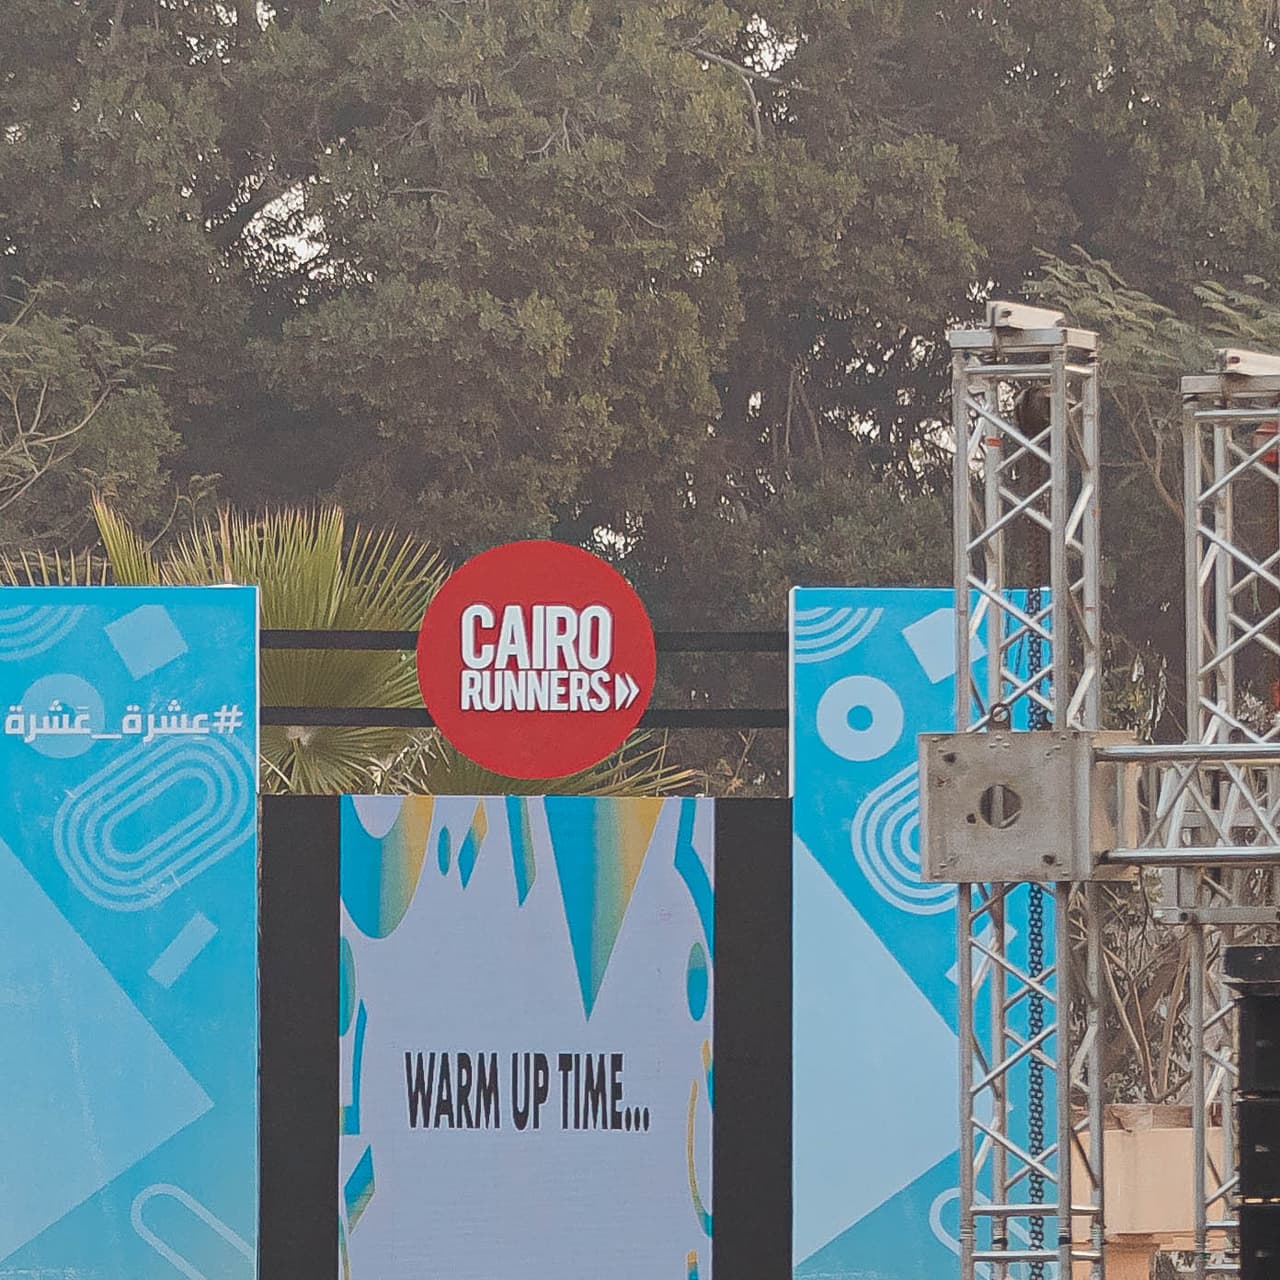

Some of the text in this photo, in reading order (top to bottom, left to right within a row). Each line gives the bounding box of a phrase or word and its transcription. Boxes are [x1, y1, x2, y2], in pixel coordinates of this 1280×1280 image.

[461, 604, 612, 670] CAIRO
[461, 669, 611, 712] RUNNERS
[405, 1052, 650, 1132] WARM UP TIME...
